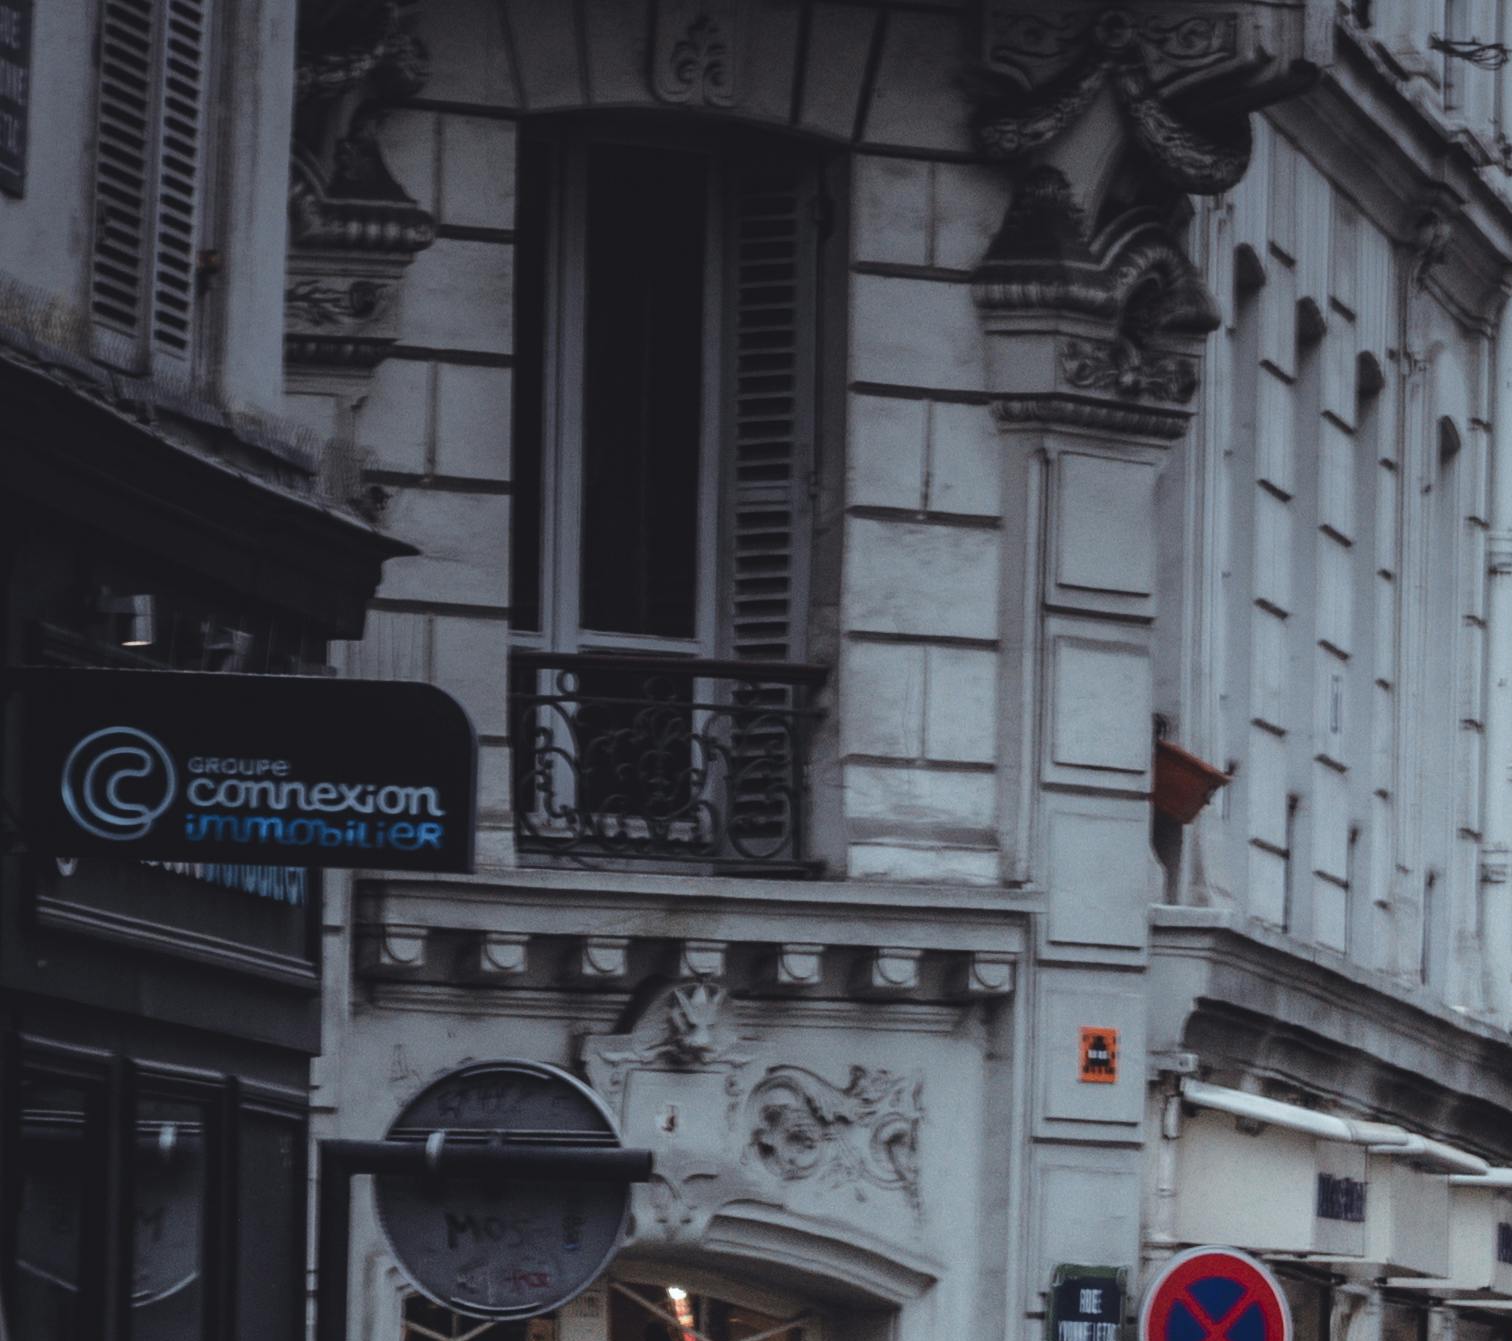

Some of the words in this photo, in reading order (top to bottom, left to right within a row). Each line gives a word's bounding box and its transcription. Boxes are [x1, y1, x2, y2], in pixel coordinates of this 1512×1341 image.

[187, 757, 290, 777] GROUPE
[186, 777, 447, 817] connexion
[184, 813, 443, 850] immobilier
